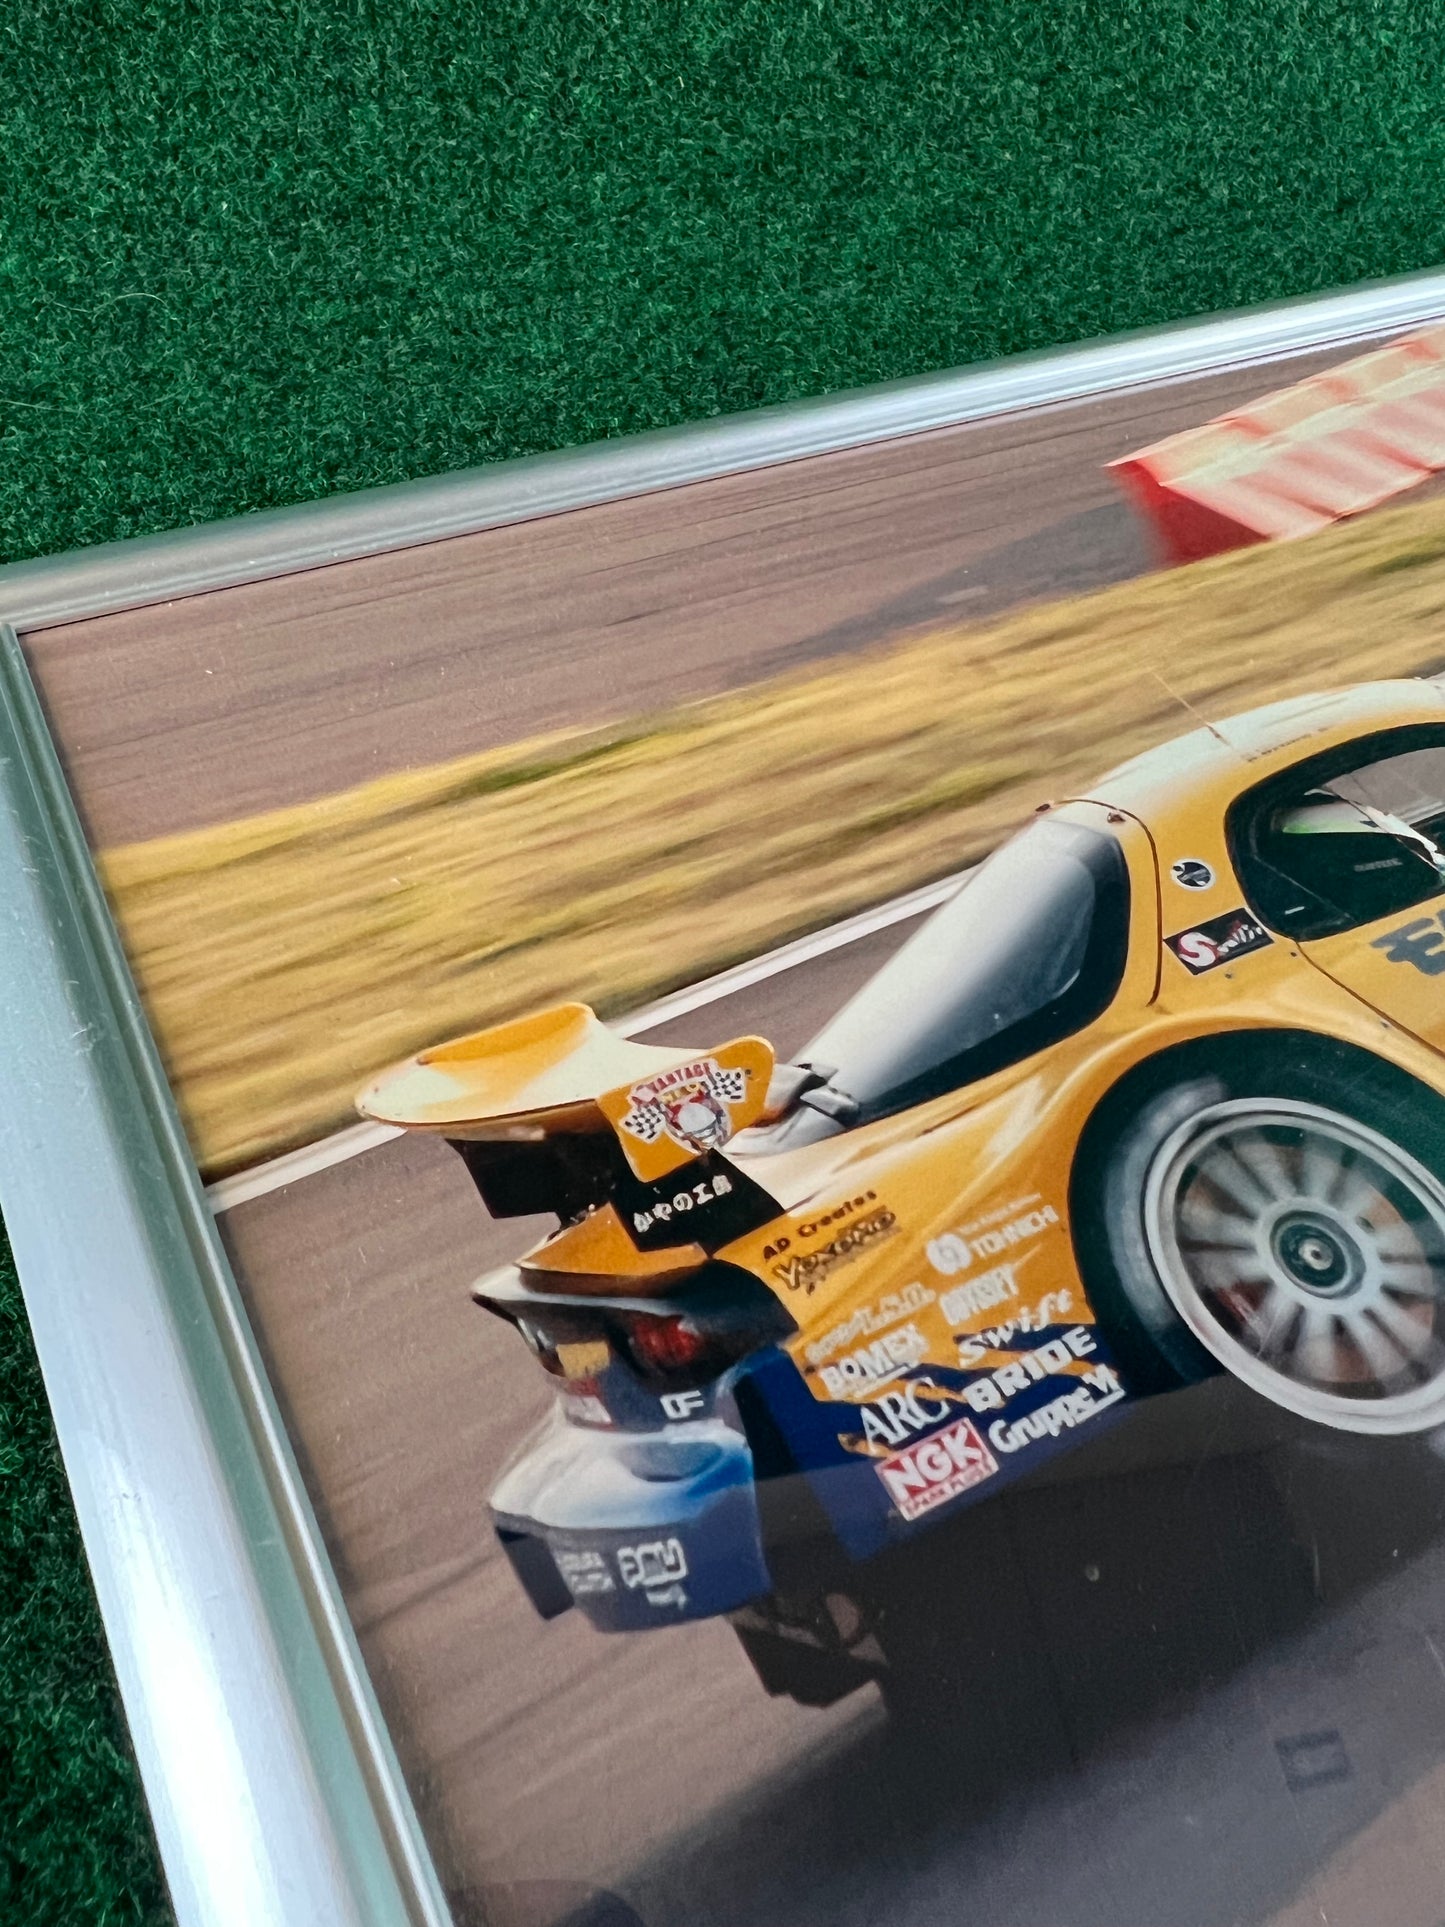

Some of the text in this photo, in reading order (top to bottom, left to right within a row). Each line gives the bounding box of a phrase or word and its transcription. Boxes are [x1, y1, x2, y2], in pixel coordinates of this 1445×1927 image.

[962, 1325, 1097, 1413] BRIDE
[860, 1376, 951, 1446] ARC
[883, 1423, 985, 1500] NGK
